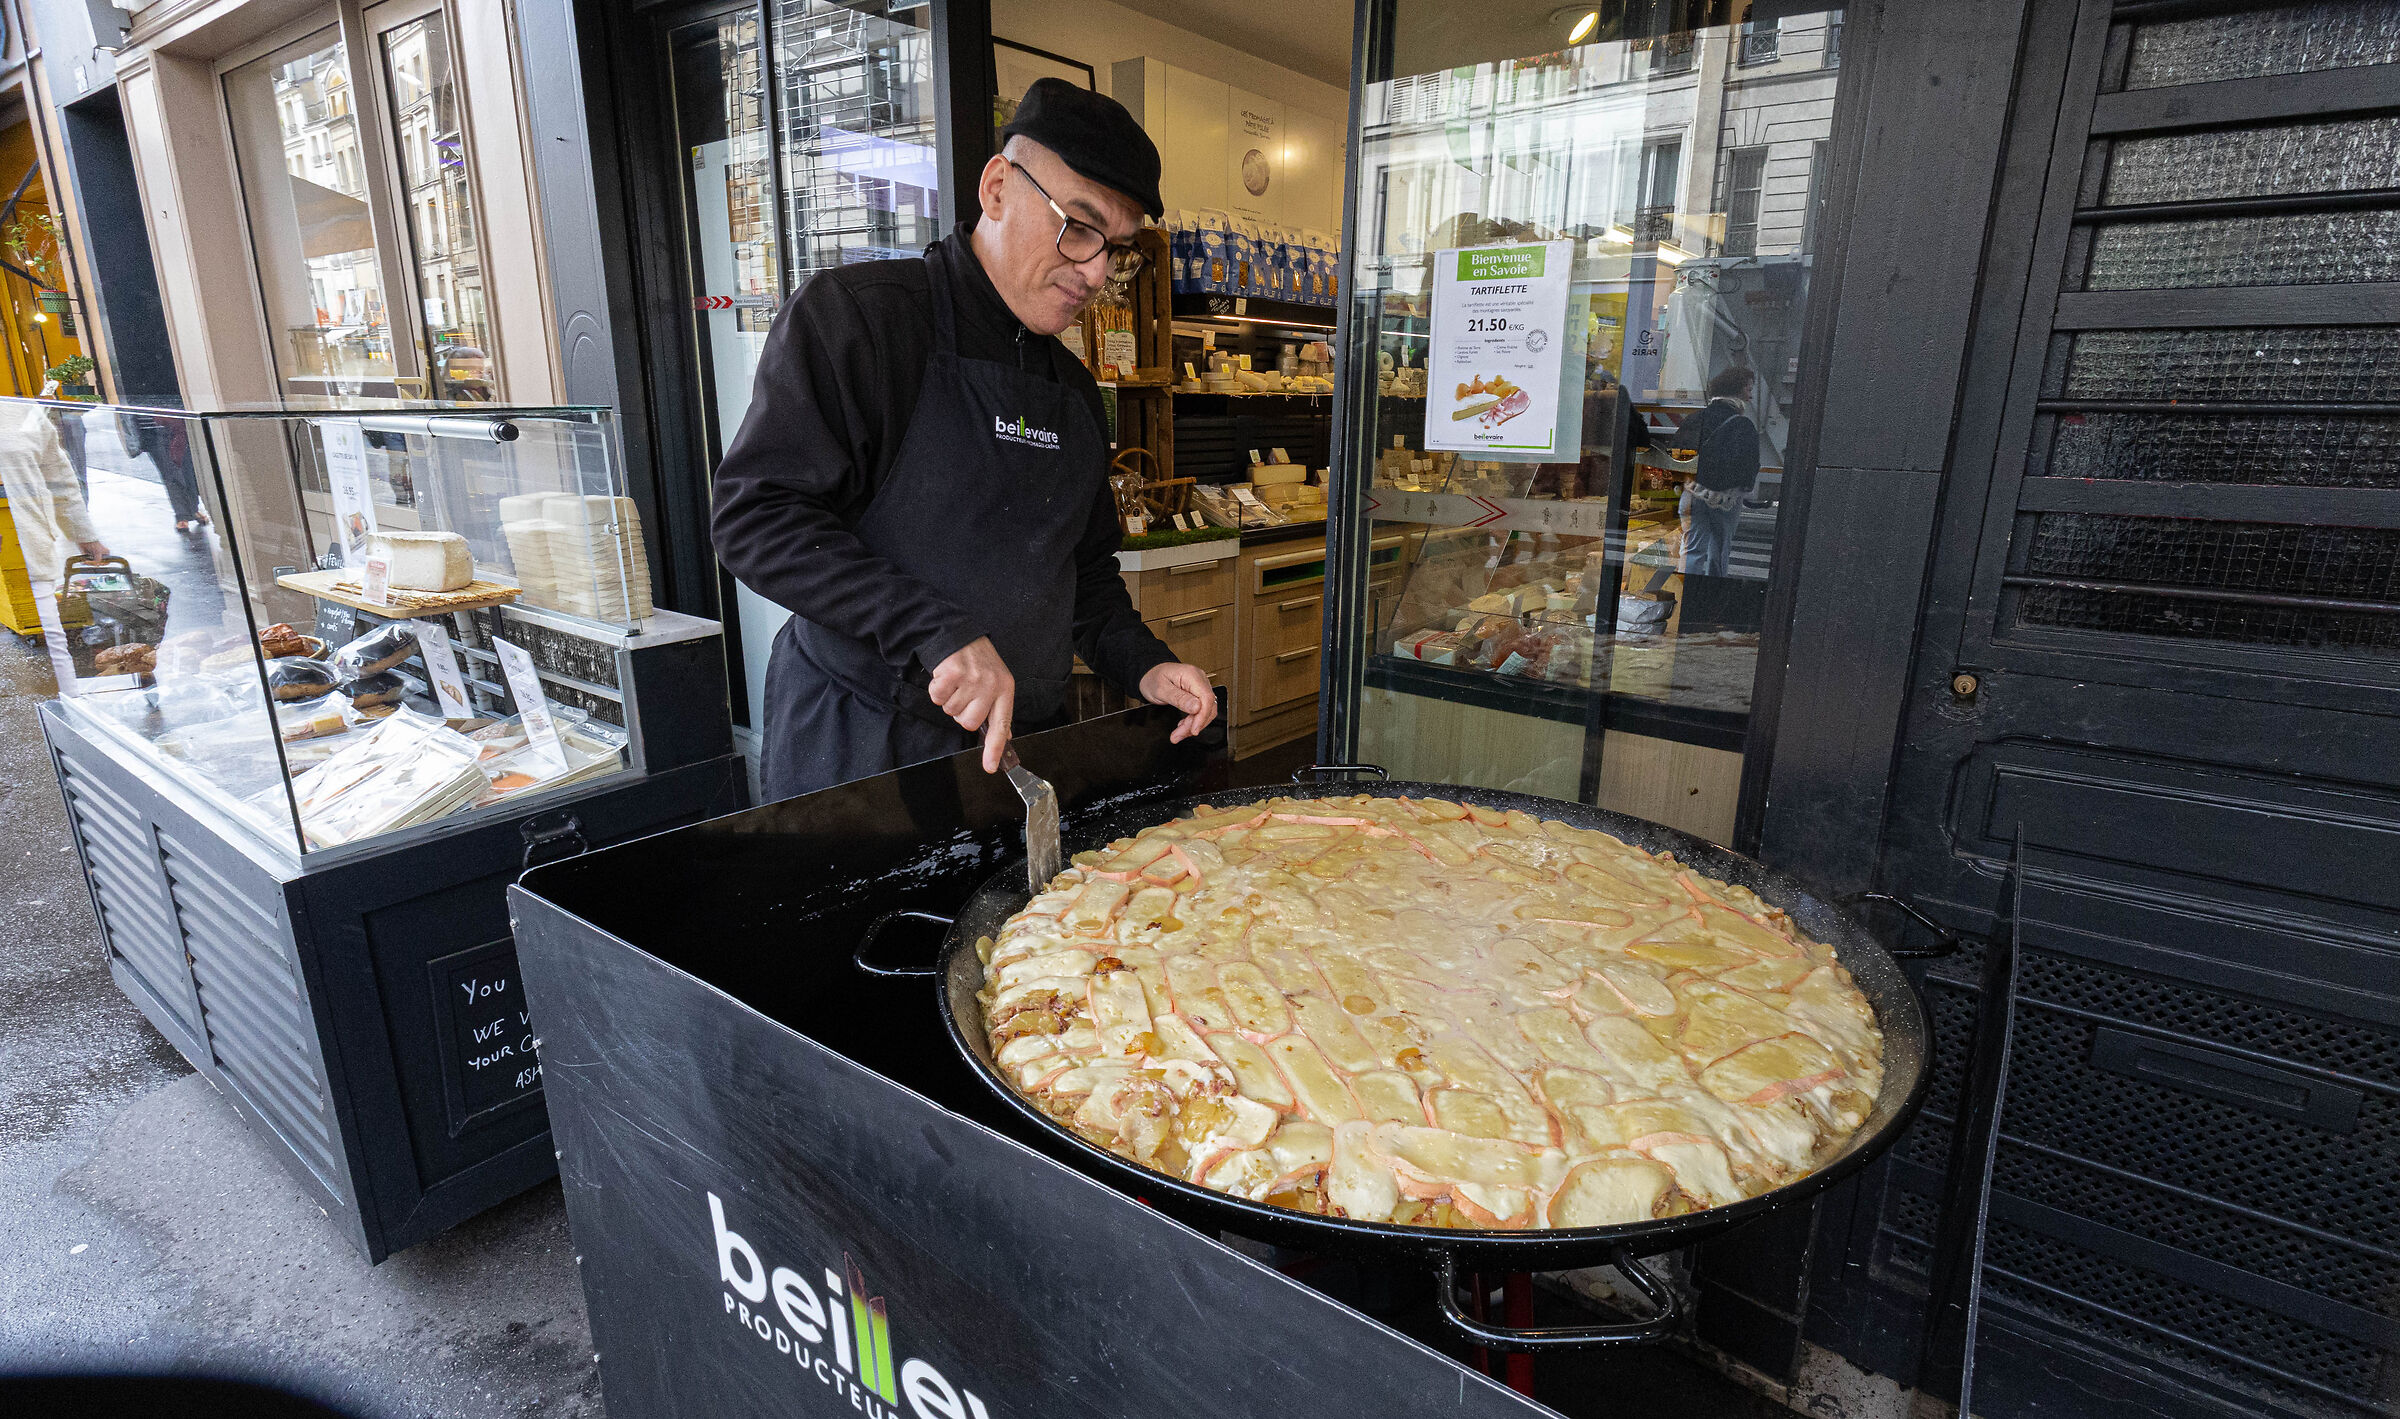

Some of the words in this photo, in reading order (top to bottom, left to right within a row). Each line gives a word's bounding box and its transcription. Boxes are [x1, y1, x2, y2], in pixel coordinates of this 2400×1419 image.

[1471, 253, 1532, 265] Bienvenue
[1473, 267, 1487, 277] en
[1490, 264, 1528, 276] Savoie
[1471, 285, 1528, 295] TARTIFLETTE
[1468, 318, 1507, 332] 21.50
[1508, 323, 1525, 331] €/KG
[996, 416, 1058, 443] beillevaire
[1474, 432, 1503, 440] beillevaire
[473, 1018, 505, 1044] WE
[468, 1045, 514, 1070] YOUR
